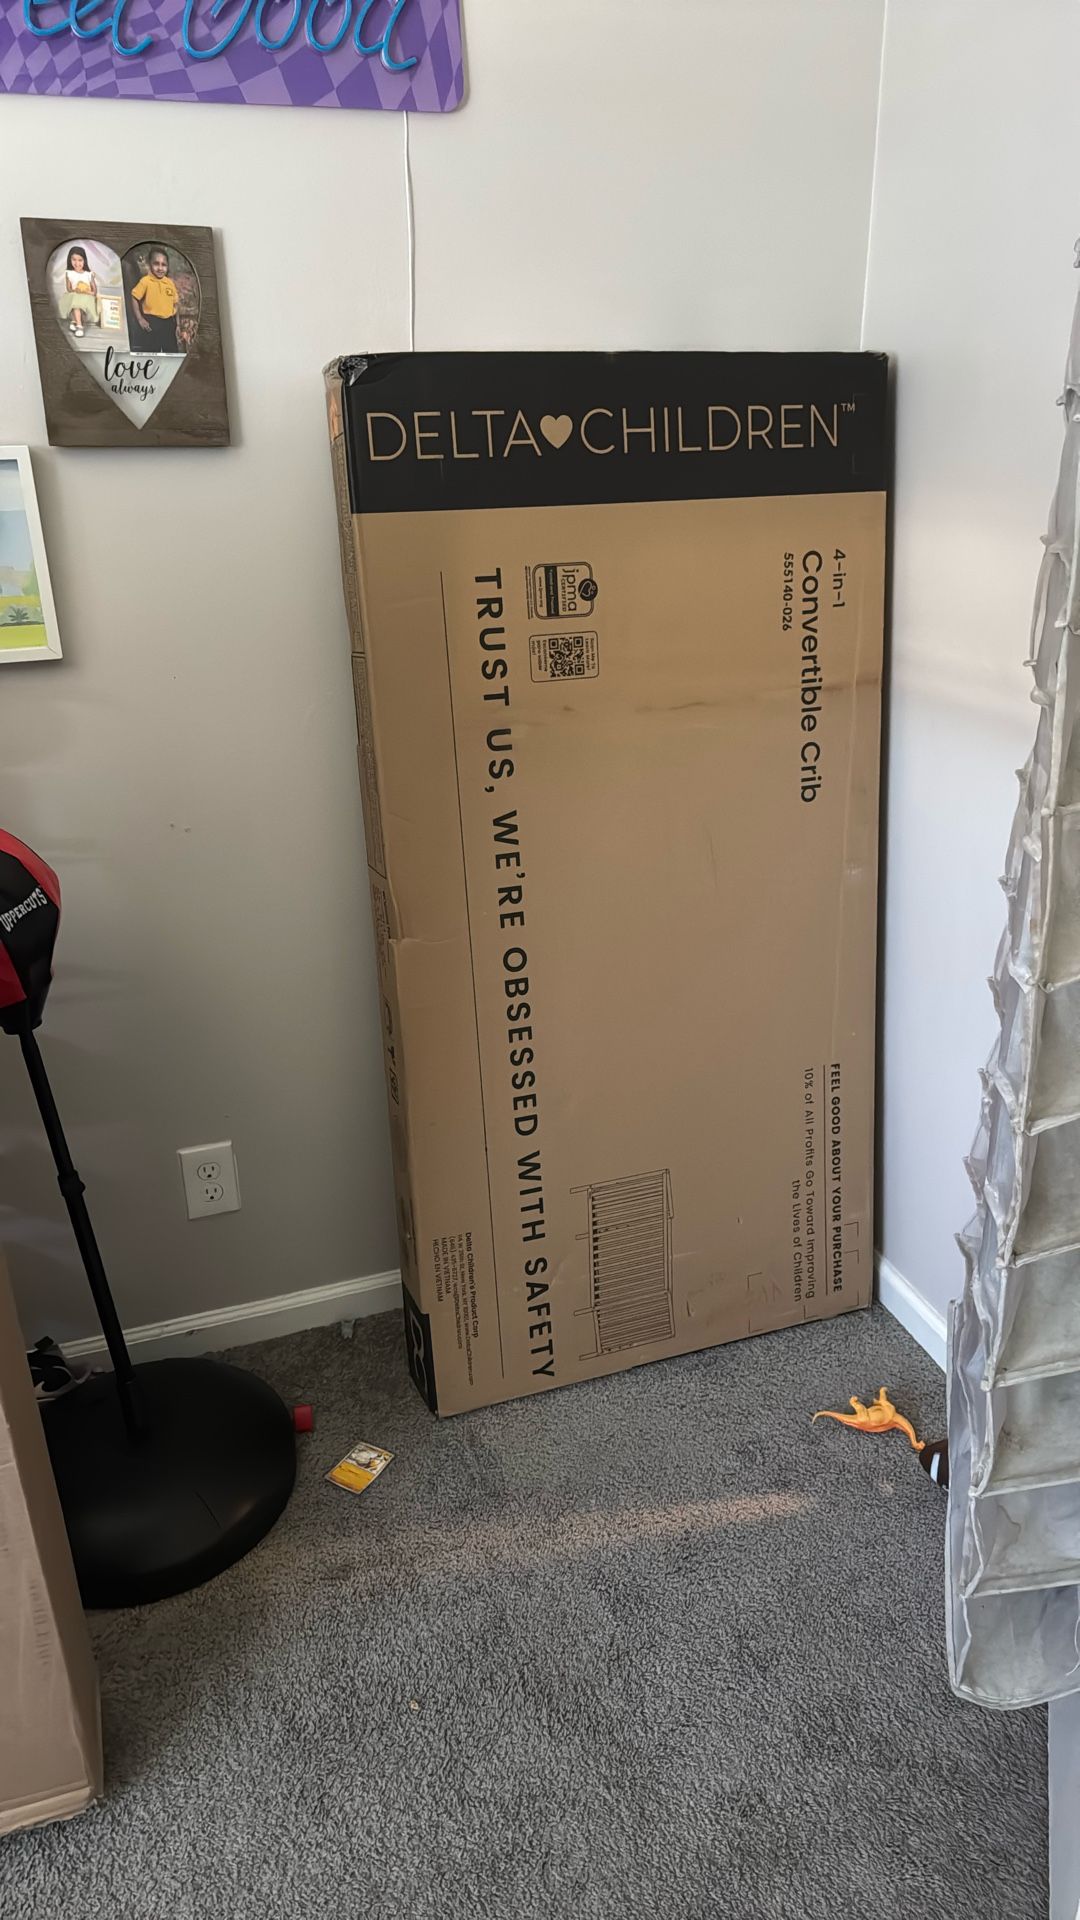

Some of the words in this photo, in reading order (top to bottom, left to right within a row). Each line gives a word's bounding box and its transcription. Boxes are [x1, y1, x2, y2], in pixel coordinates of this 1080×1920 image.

[104, 346, 160, 382] love
[111, 379, 156, 401] always
[366, 409, 543, 461] DELTA
[562, 568, 579, 611] jpma
[781, 551, 794, 632] 555140-026
[832, 548, 847, 608] 4-in-1
[474, 566, 510, 707] TRUST
[800, 550, 823, 732] Convertible
[484, 727, 515, 794] US,
[800, 741, 822, 803] Crib
[492, 809, 526, 930] WE'RE
[0, 887, 48, 932] UPPERCUTS
[502, 946, 539, 1137] OBSESSED
[804, 1067, 814, 1089] 10%
[804, 1093, 814, 1105] of
[831, 1063, 841, 1093] FEEL
[805, 1110, 814, 1125] All
[831, 1096, 841, 1135] GOOD
[805, 1129, 815, 1167] Profits
[832, 1139, 841, 1182] ABOUT
[517, 1149, 546, 1244] WITH
[792, 1180, 801, 1200] the
[805, 1170, 815, 1187] Go
[792, 1203, 802, 1233] Lives
[806, 1190, 816, 1235] Toward
[832, 1186, 842, 1222] YOUR
[793, 1236, 802, 1248] of
[832, 1226, 842, 1293] PURCHASE
[435, 1273, 443, 1302] VIETNAM
[467, 1253, 475, 1290] Children's
[793, 1252, 802, 1302] Children
[804, 1239, 816, 1299] Improving
[524, 1256, 556, 1378] SAFETY
